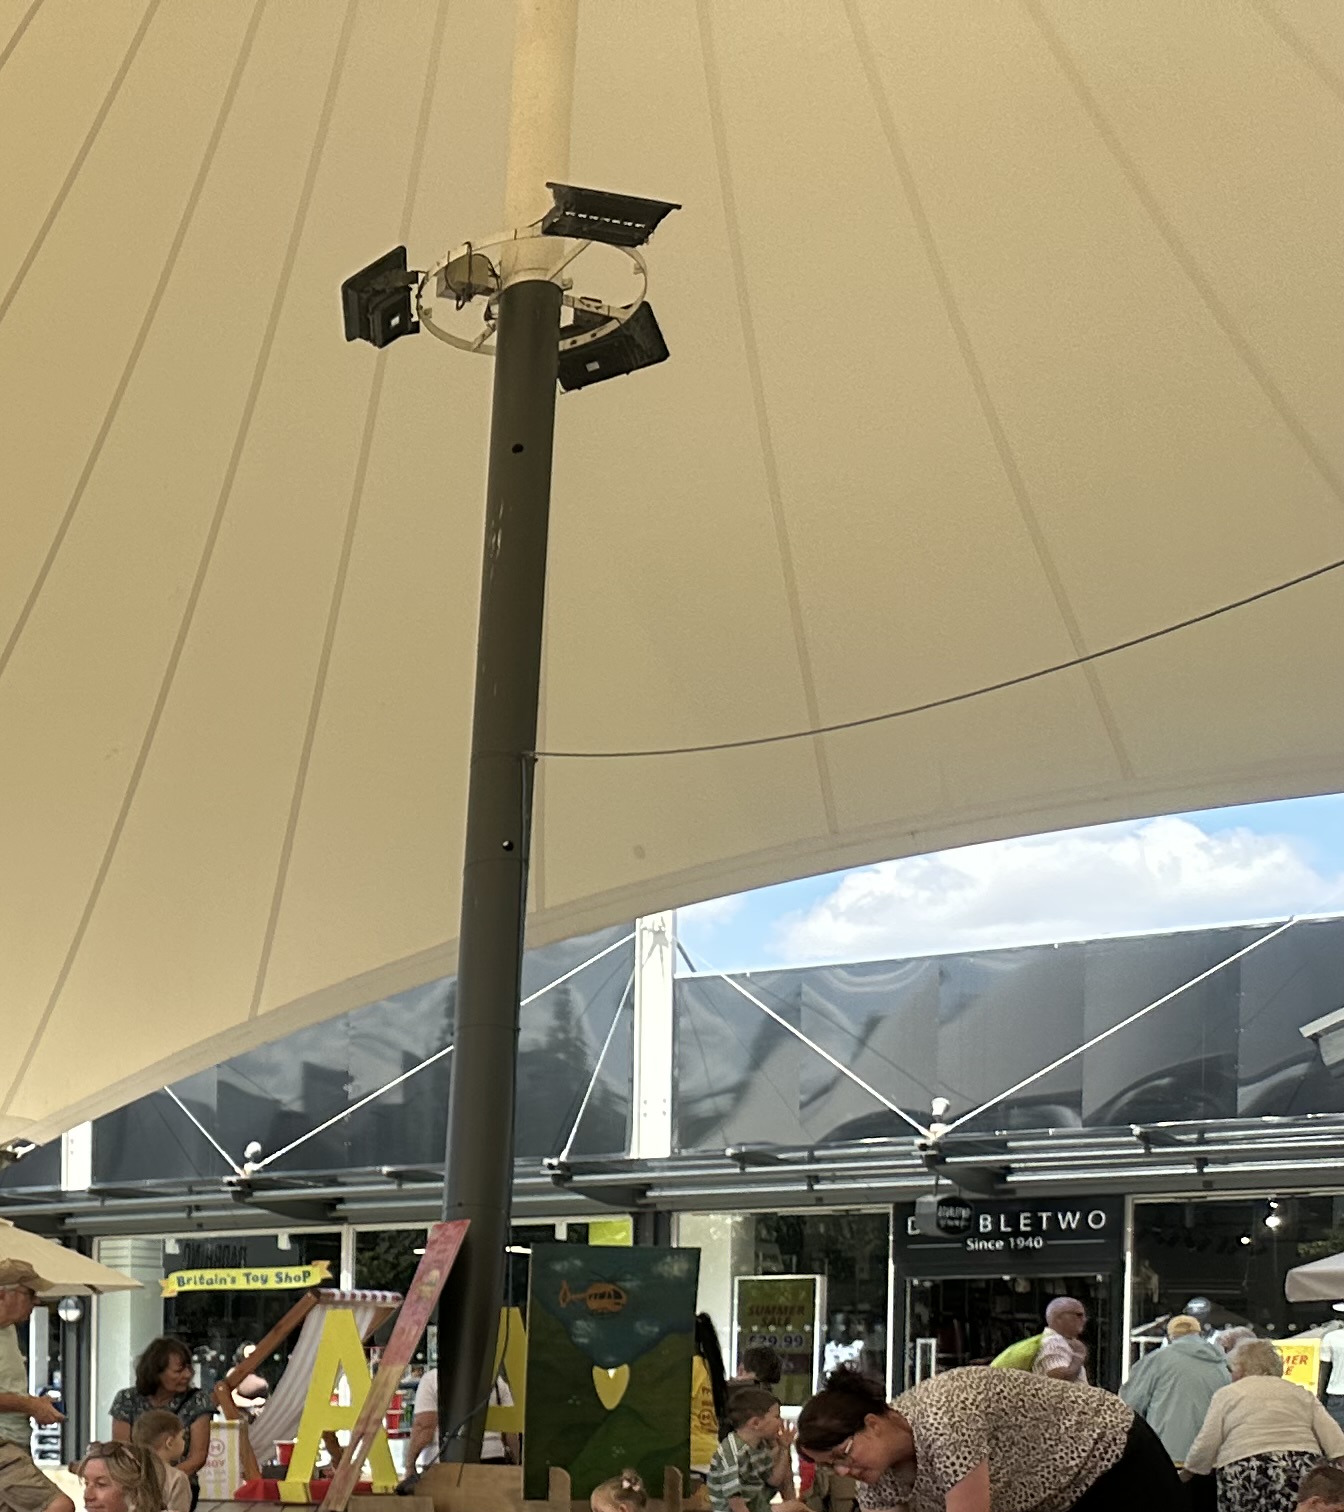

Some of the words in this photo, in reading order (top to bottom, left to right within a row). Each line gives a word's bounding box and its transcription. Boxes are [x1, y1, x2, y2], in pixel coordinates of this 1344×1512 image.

[966, 1238, 1004, 1251] Since
[1009, 1236, 1043, 1250] 1940
[176, 1273, 237, 1287] Britain's
[243, 1272, 269, 1285] Toy
[748, 1305, 805, 1316] SUMMER
